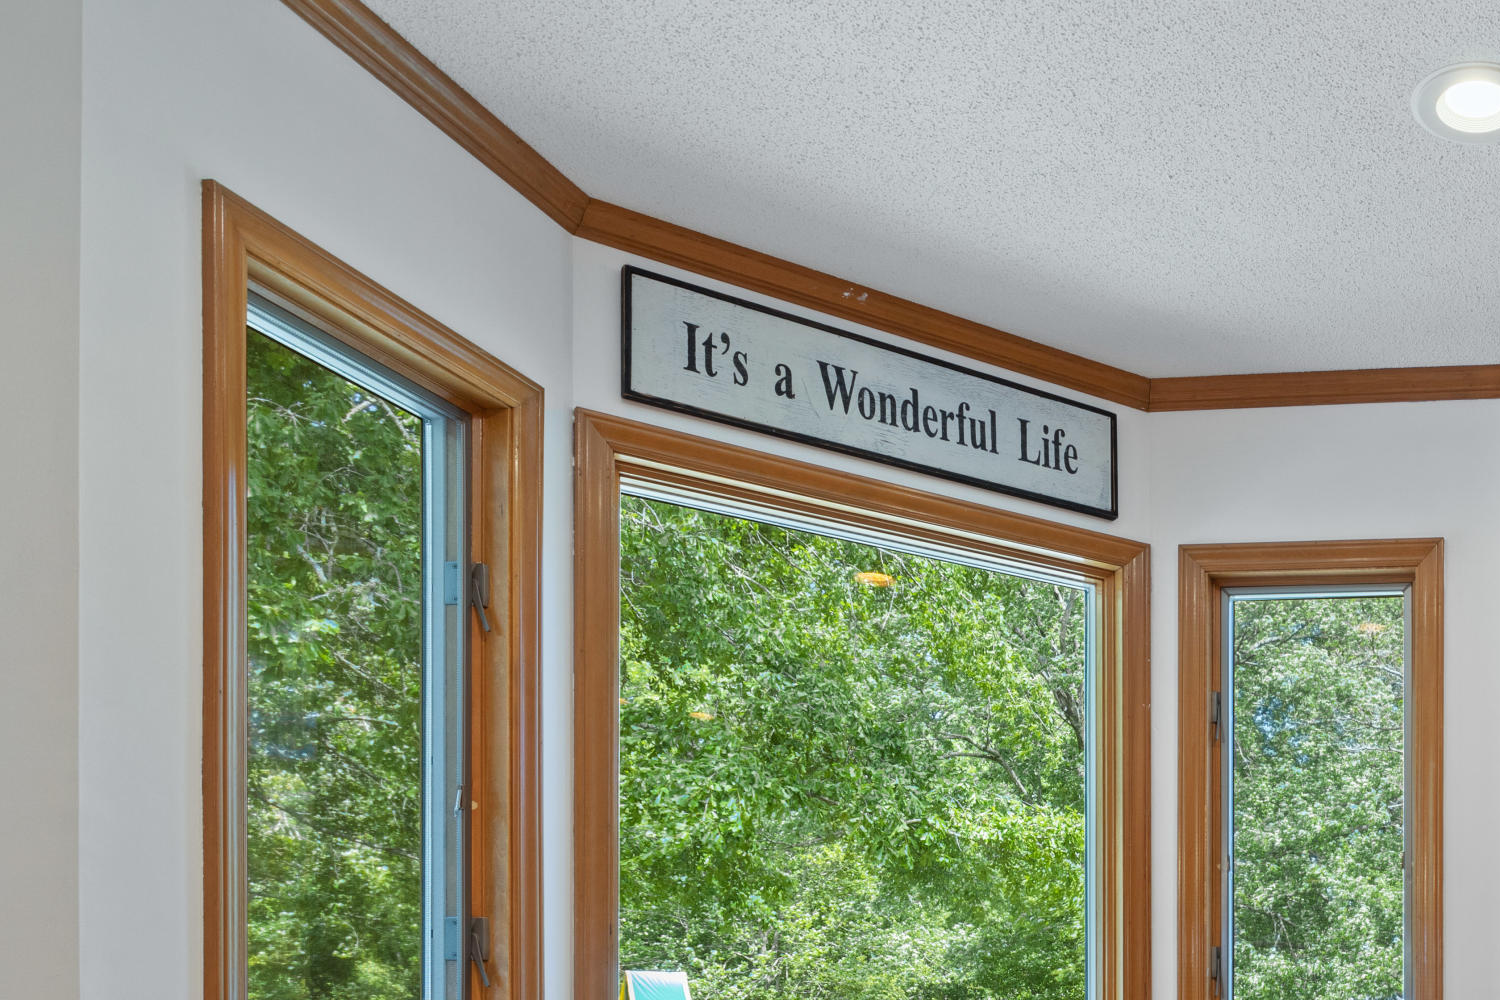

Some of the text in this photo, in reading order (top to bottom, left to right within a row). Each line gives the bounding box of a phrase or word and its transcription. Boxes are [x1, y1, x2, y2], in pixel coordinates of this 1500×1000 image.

[682, 321, 1079, 475] It's a Wonderful Life
